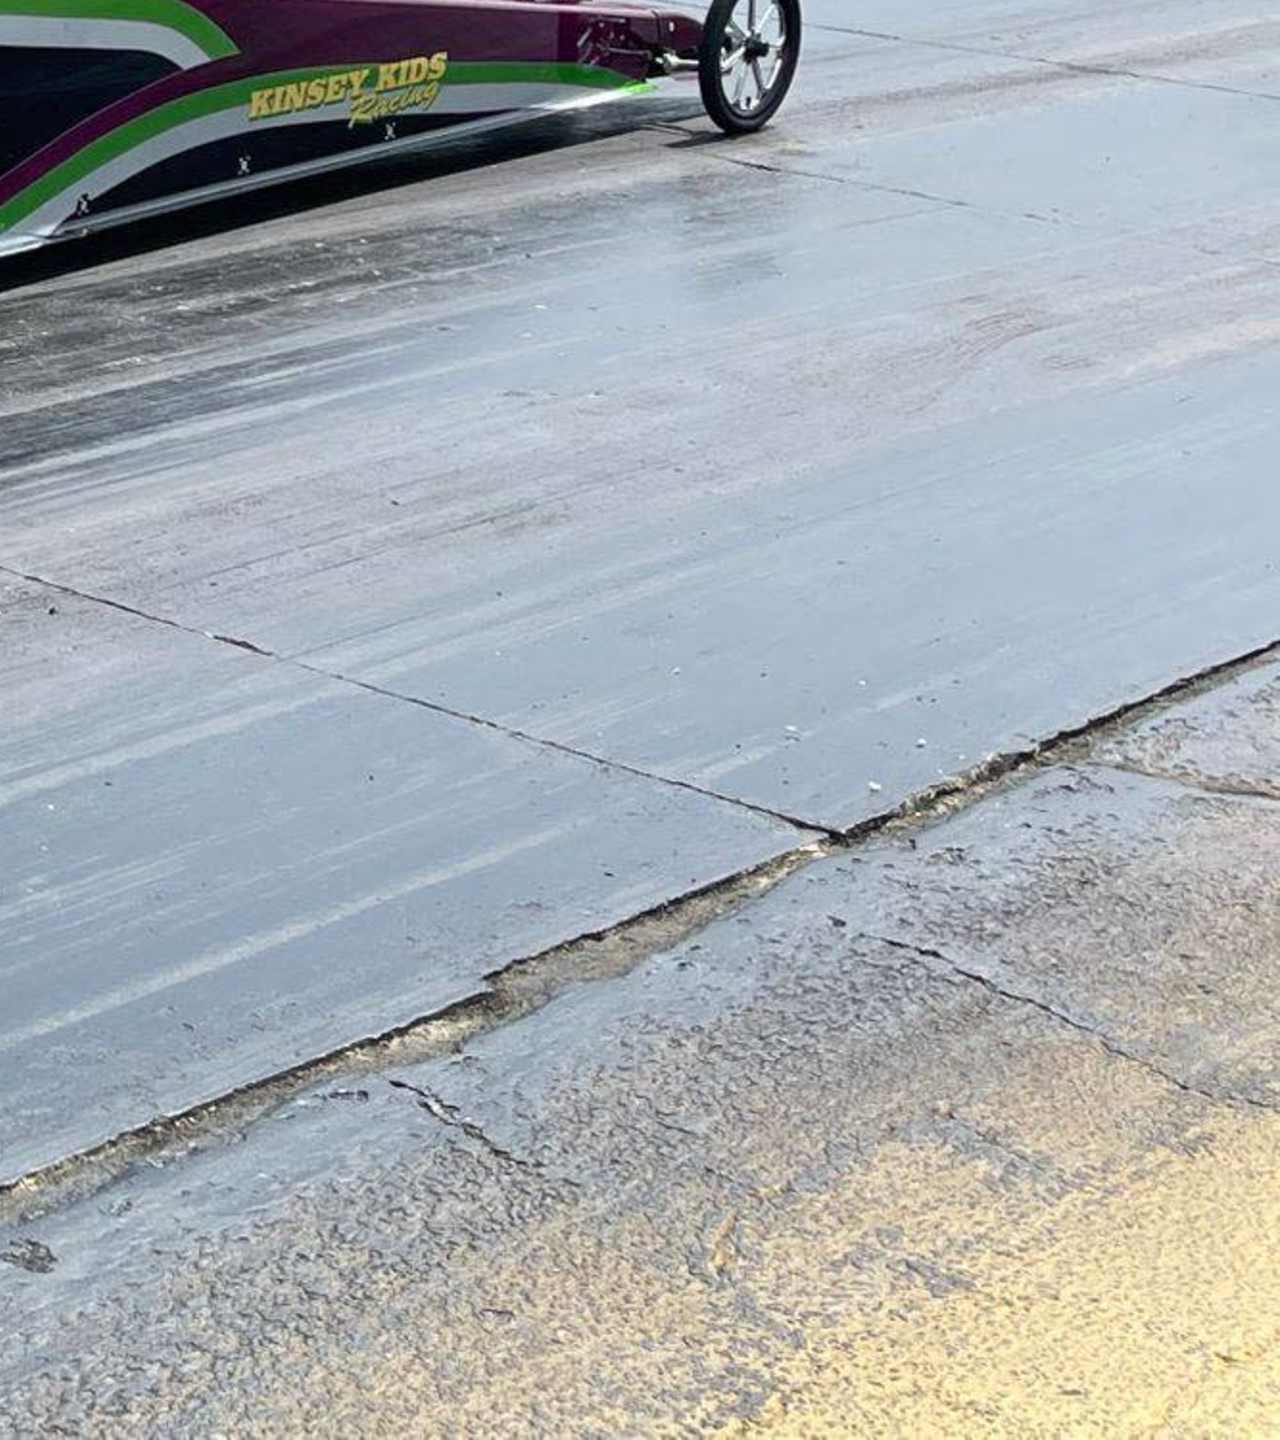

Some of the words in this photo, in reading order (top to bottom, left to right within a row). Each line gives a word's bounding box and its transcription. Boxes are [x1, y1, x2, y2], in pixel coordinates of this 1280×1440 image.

[248, 68, 371, 122] KINSEY
[375, 51, 448, 93] KIDS
[347, 81, 439, 129] Racing
